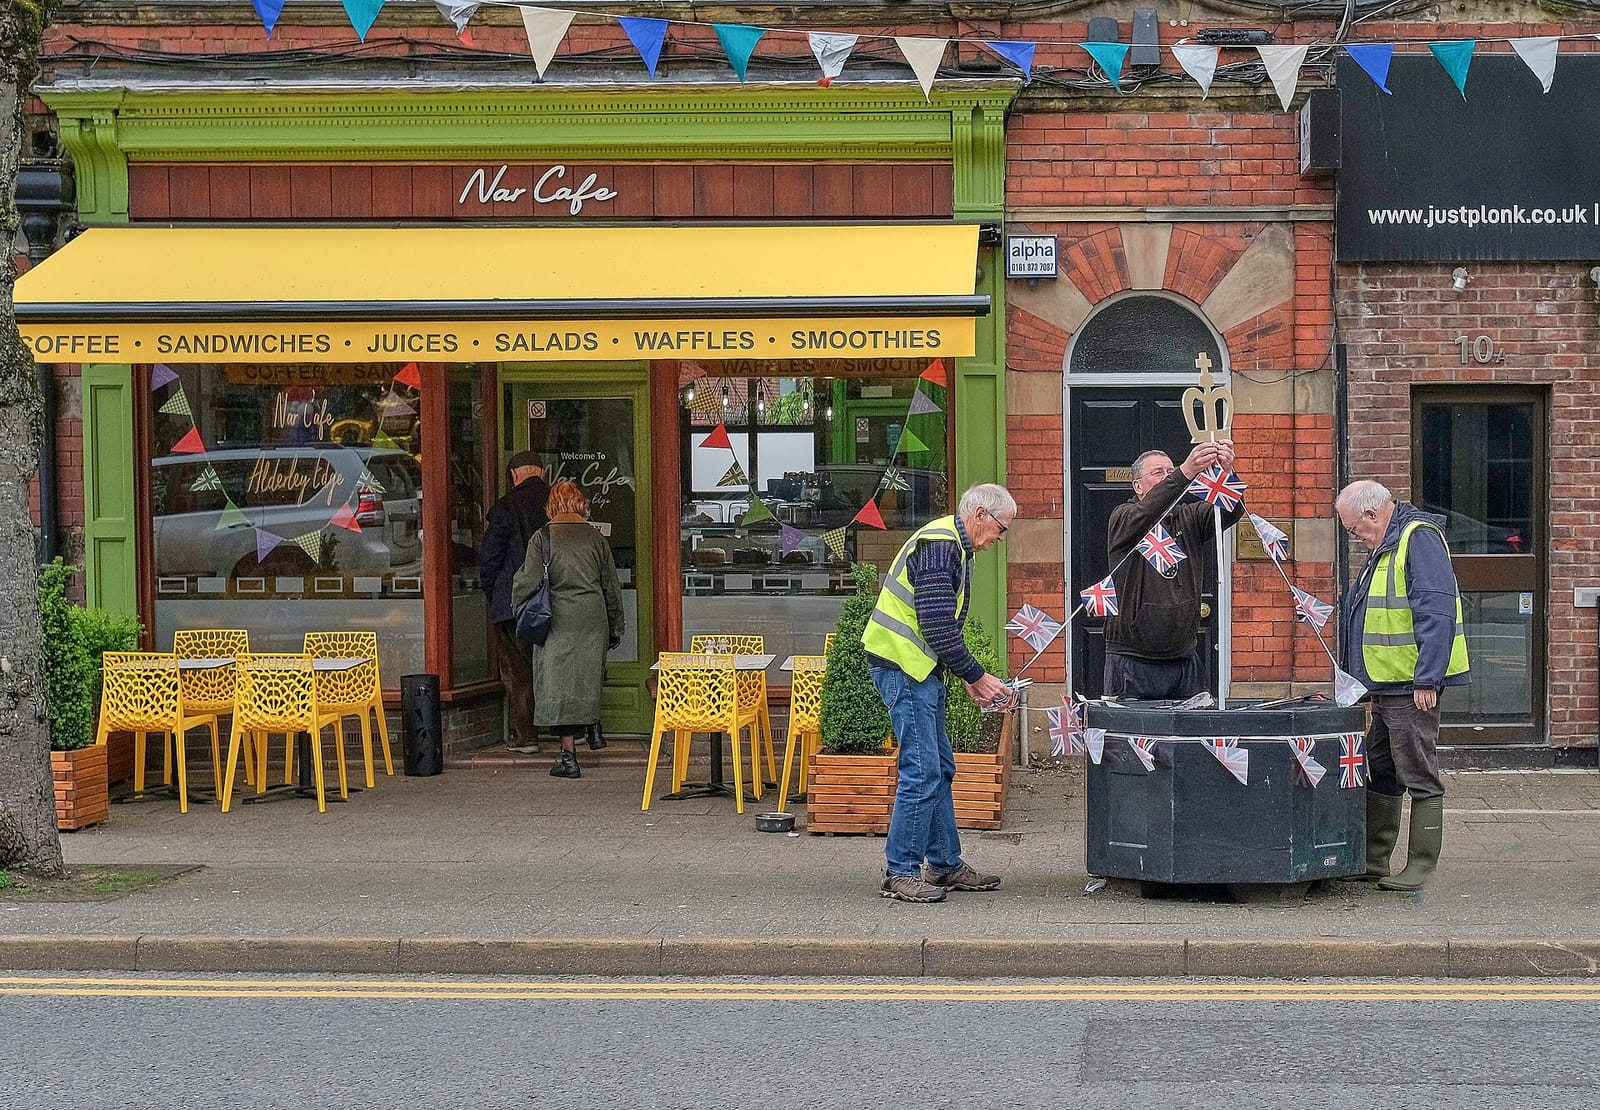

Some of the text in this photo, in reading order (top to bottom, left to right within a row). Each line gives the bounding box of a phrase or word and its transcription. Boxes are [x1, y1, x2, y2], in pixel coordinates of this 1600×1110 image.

[459, 165, 617, 215] Nar Cafe
[1368, 205, 1587, 227] www.justplonk.co.uk
[1012, 241, 1053, 260] alpha
[1012, 263, 1025, 271] 0161
[157, 334, 331, 353] SANDWICHES
[367, 333, 458, 353] JUICES
[495, 331, 598, 352] SALADS
[635, 331, 755, 350] WAFFLES
[791, 330, 941, 349] SMOOTHIES
[1454, 335, 1509, 366] 10A
[273, 389, 334, 440] Nar Cafe
[560, 452, 606, 460] Welcome To
[247, 450, 345, 507] Alderley Edge
[581, 462, 631, 494] Cafe
